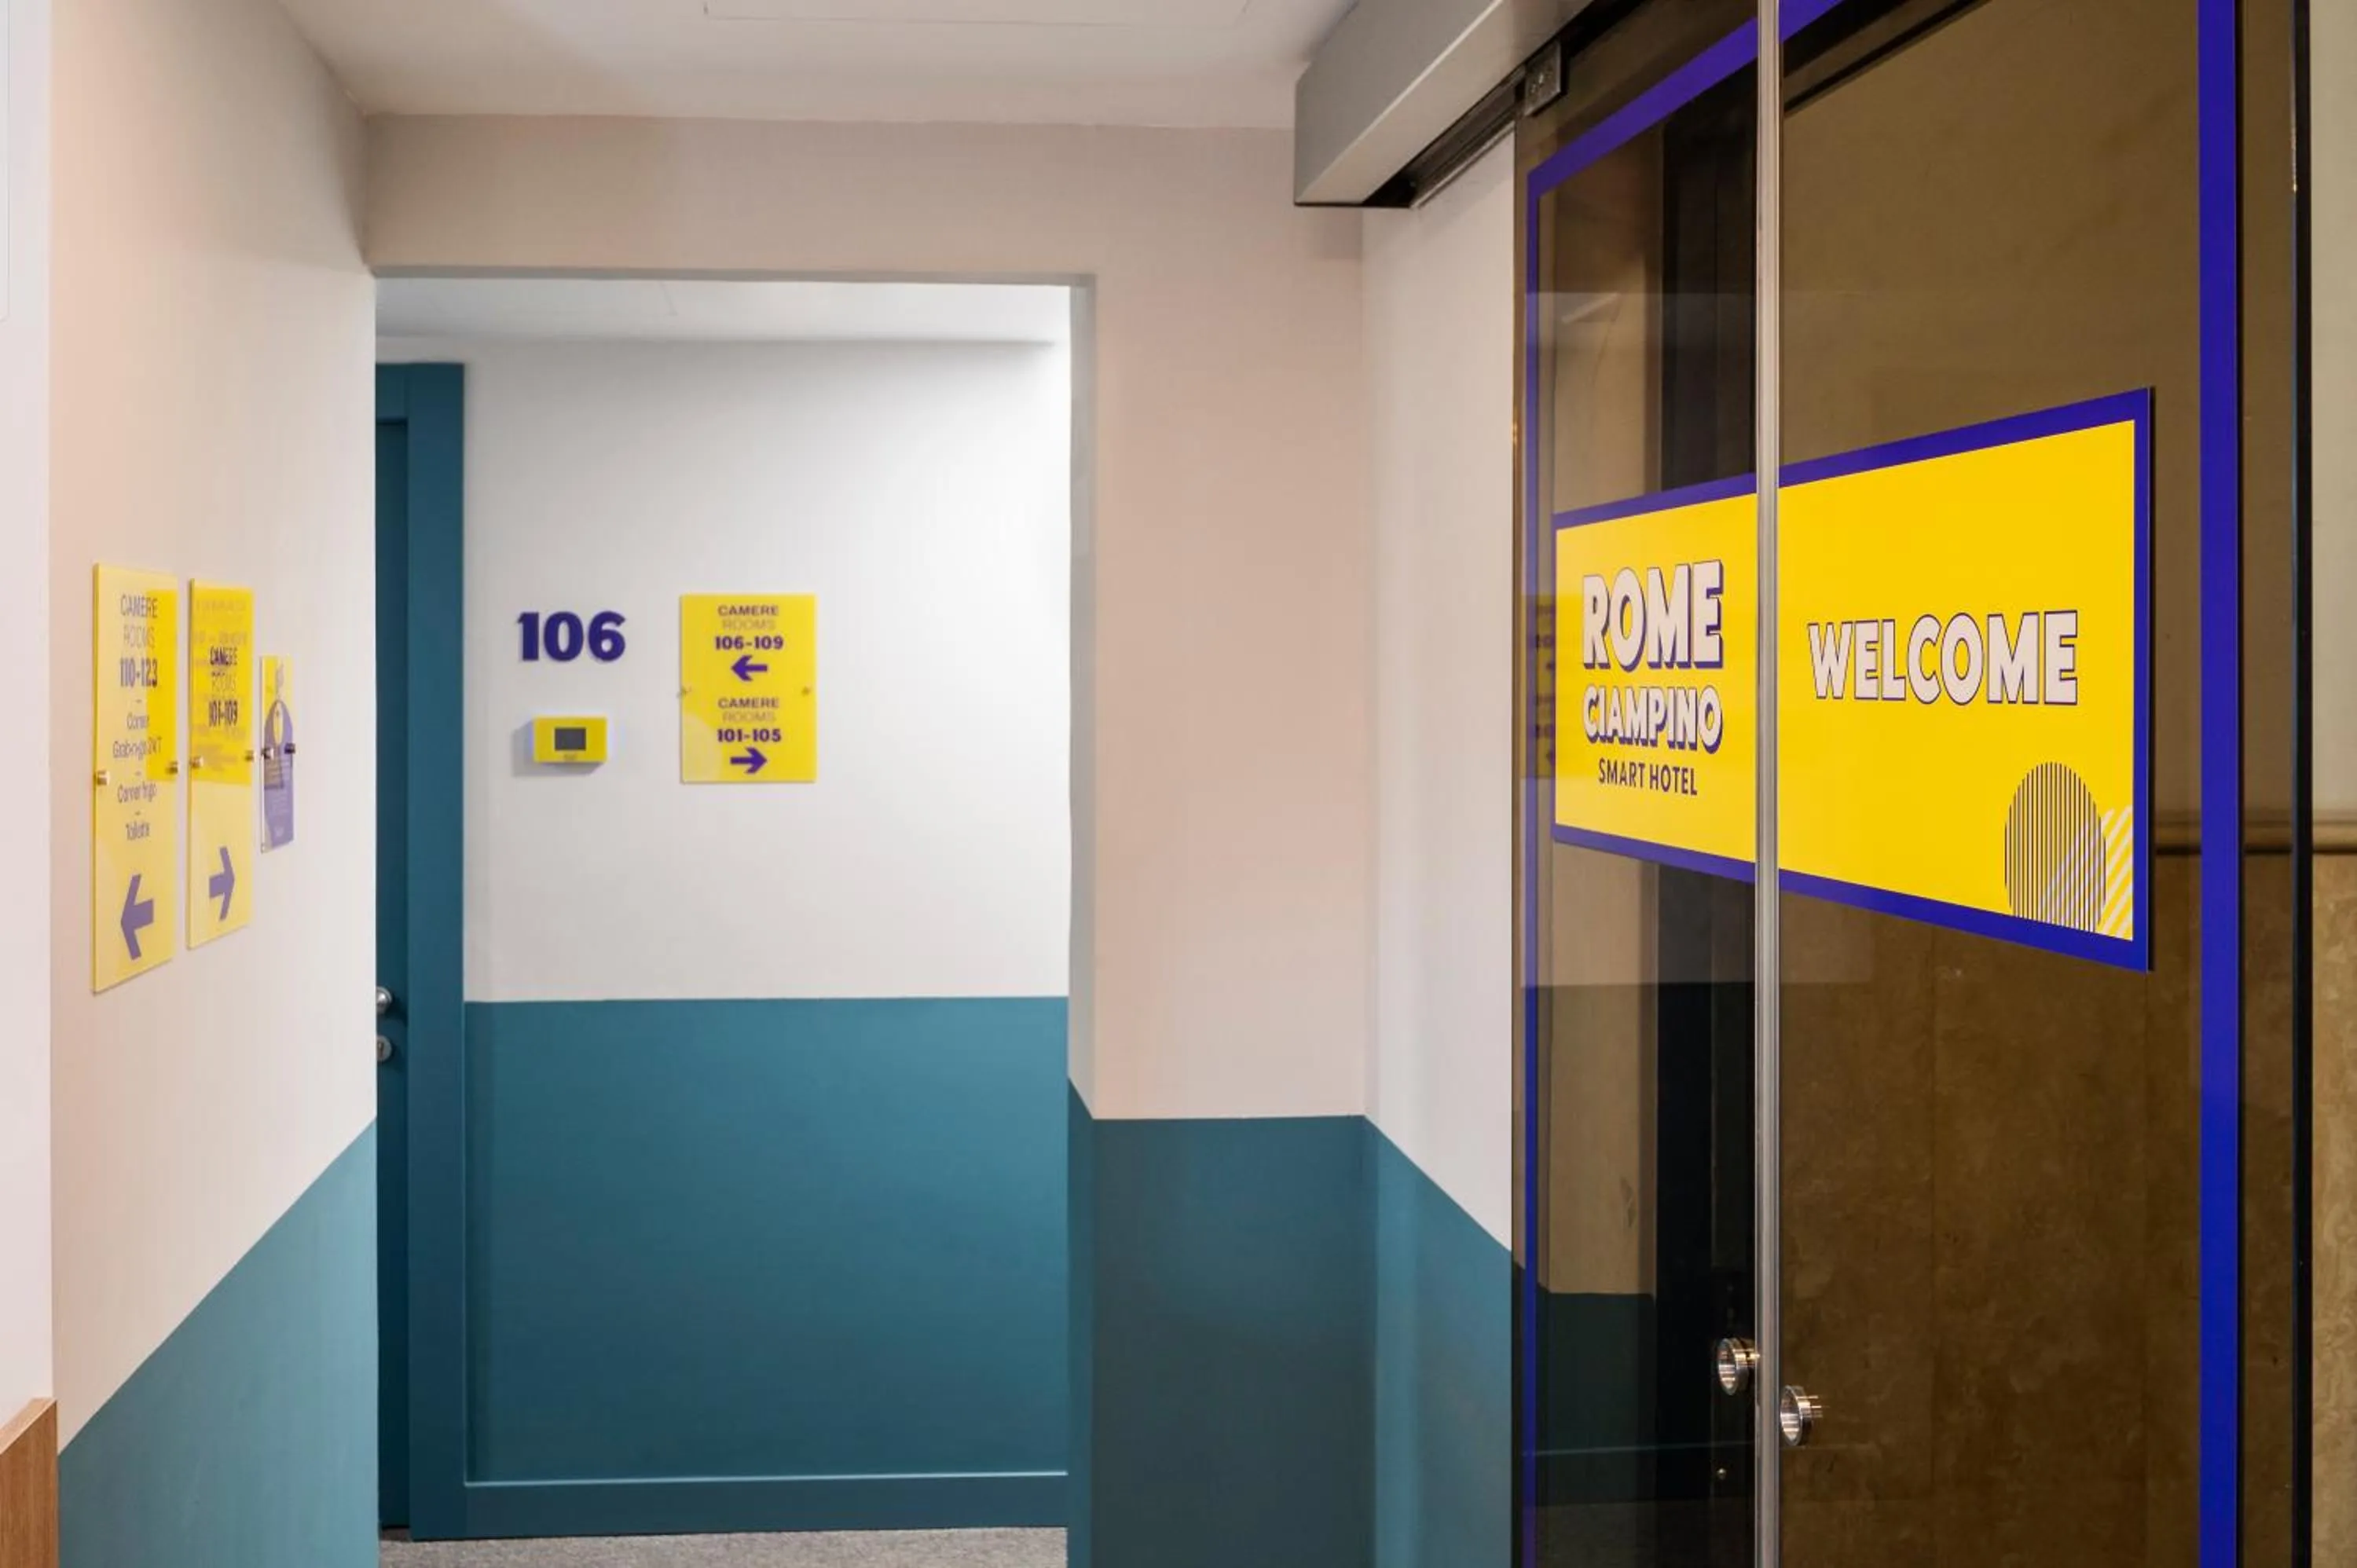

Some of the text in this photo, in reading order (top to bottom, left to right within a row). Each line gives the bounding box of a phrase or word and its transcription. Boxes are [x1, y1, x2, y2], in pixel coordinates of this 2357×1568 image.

[120, 595, 158, 618] CAMERE
[717, 605, 779, 617] CAMERE
[1583, 559, 1724, 672] ROME
[517, 610, 626, 662] 106
[723, 619, 775, 632] ROOMS
[715, 636, 784, 650] 106-109
[1808, 610, 2078, 706] WELCOME
[119, 658, 158, 688] 110-123
[717, 698, 779, 709] CAMERE
[723, 711, 775, 724] ROOMS
[1583, 684, 1724, 754] CIAMPINO
[717, 728, 782, 742] 101-105
[1599, 757, 1698, 796] SMART HOTEL
